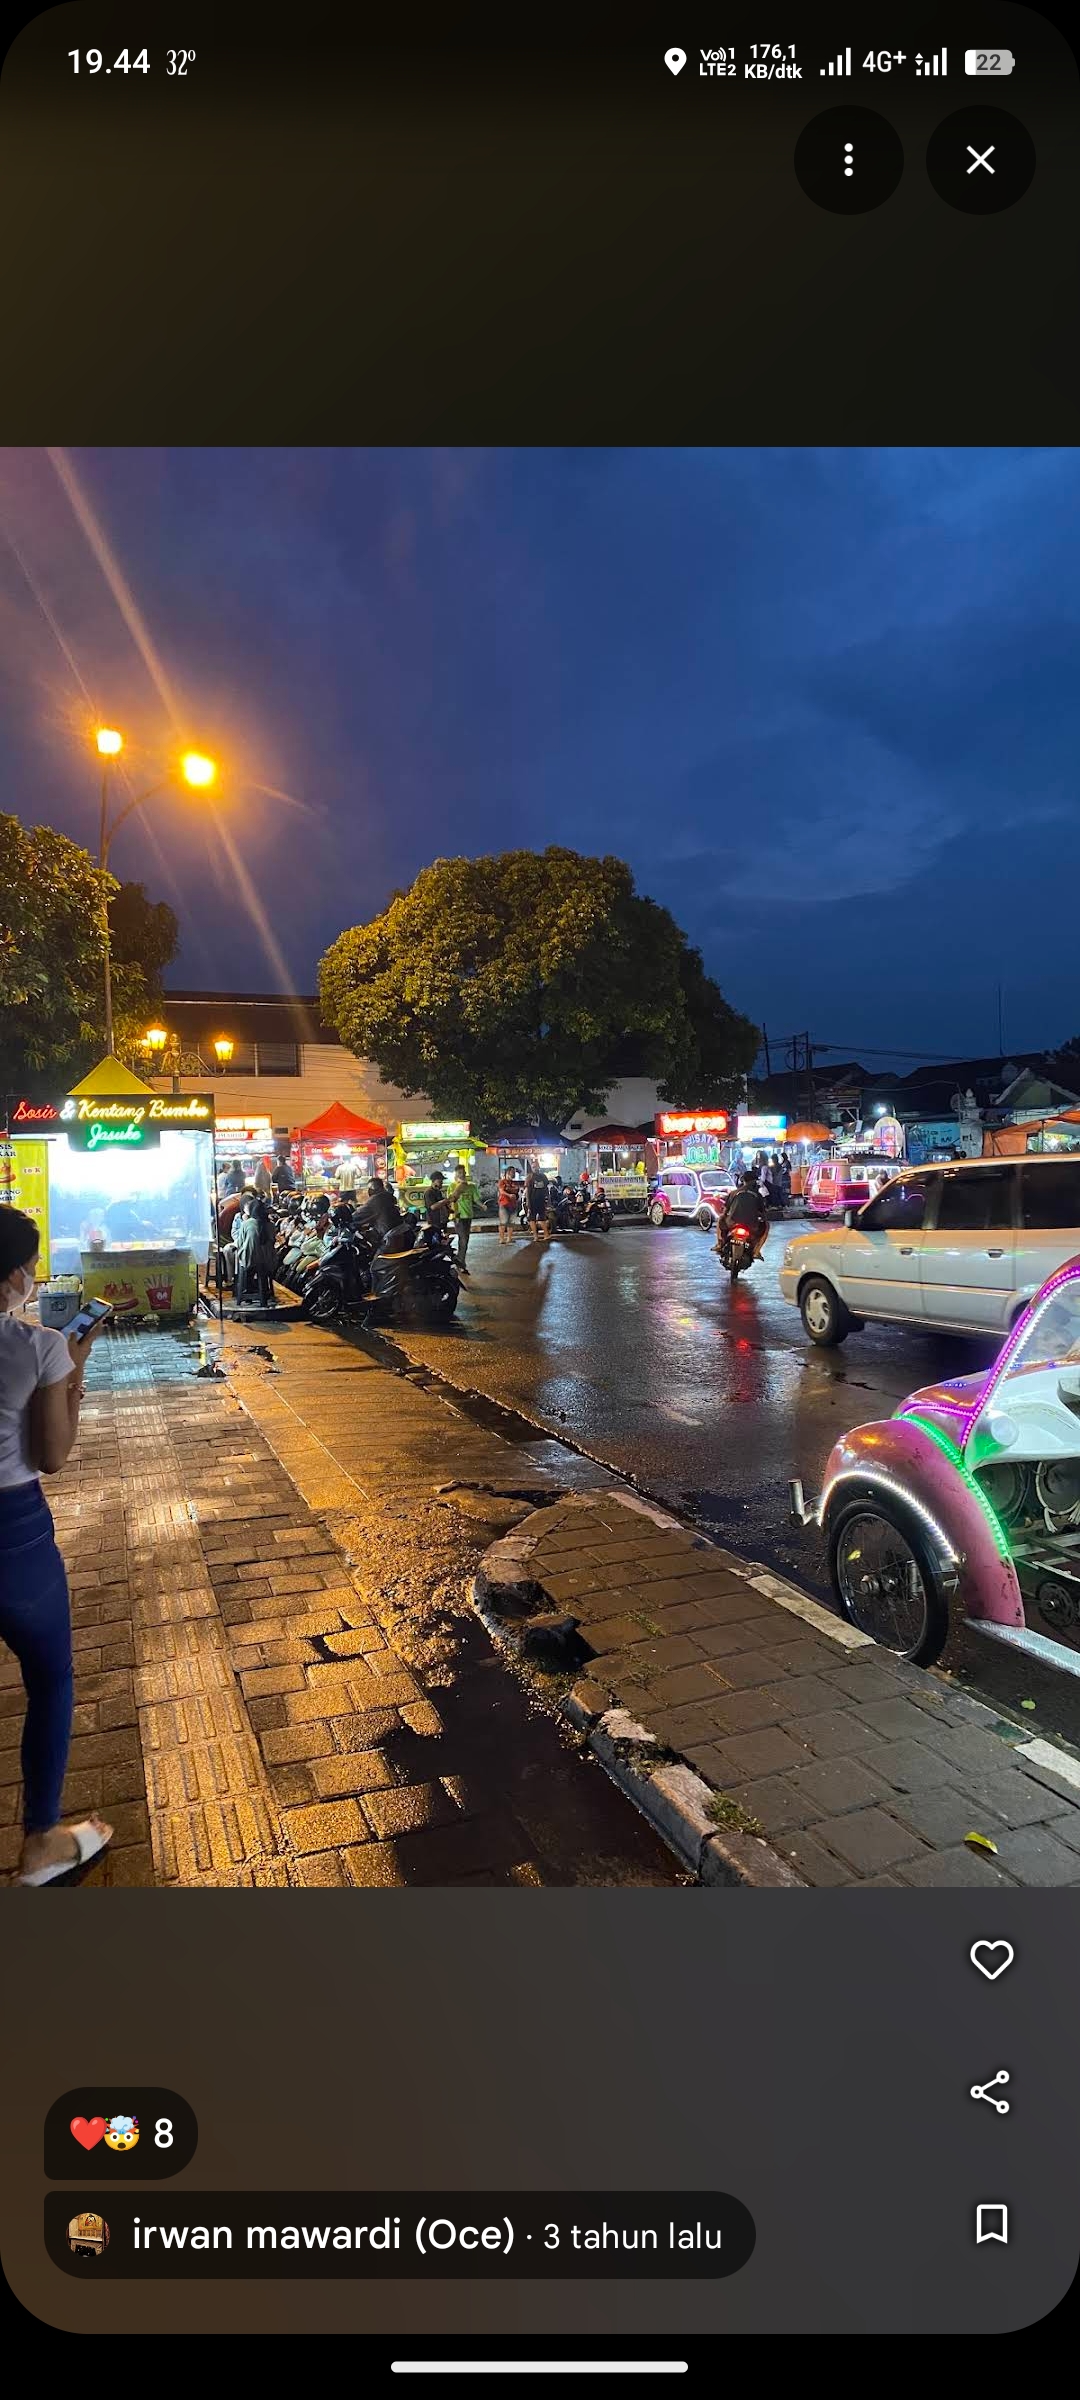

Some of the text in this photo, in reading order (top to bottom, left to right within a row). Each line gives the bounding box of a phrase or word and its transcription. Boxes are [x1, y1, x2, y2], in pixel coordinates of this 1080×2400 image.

[12, 1098, 209, 1124] Sosis & Kentang Bumbu
[86, 1122, 142, 1149] Jasuke
[685, 1133, 719, 1146] WISATA
[684, 1146, 720, 1164] JOGJA
